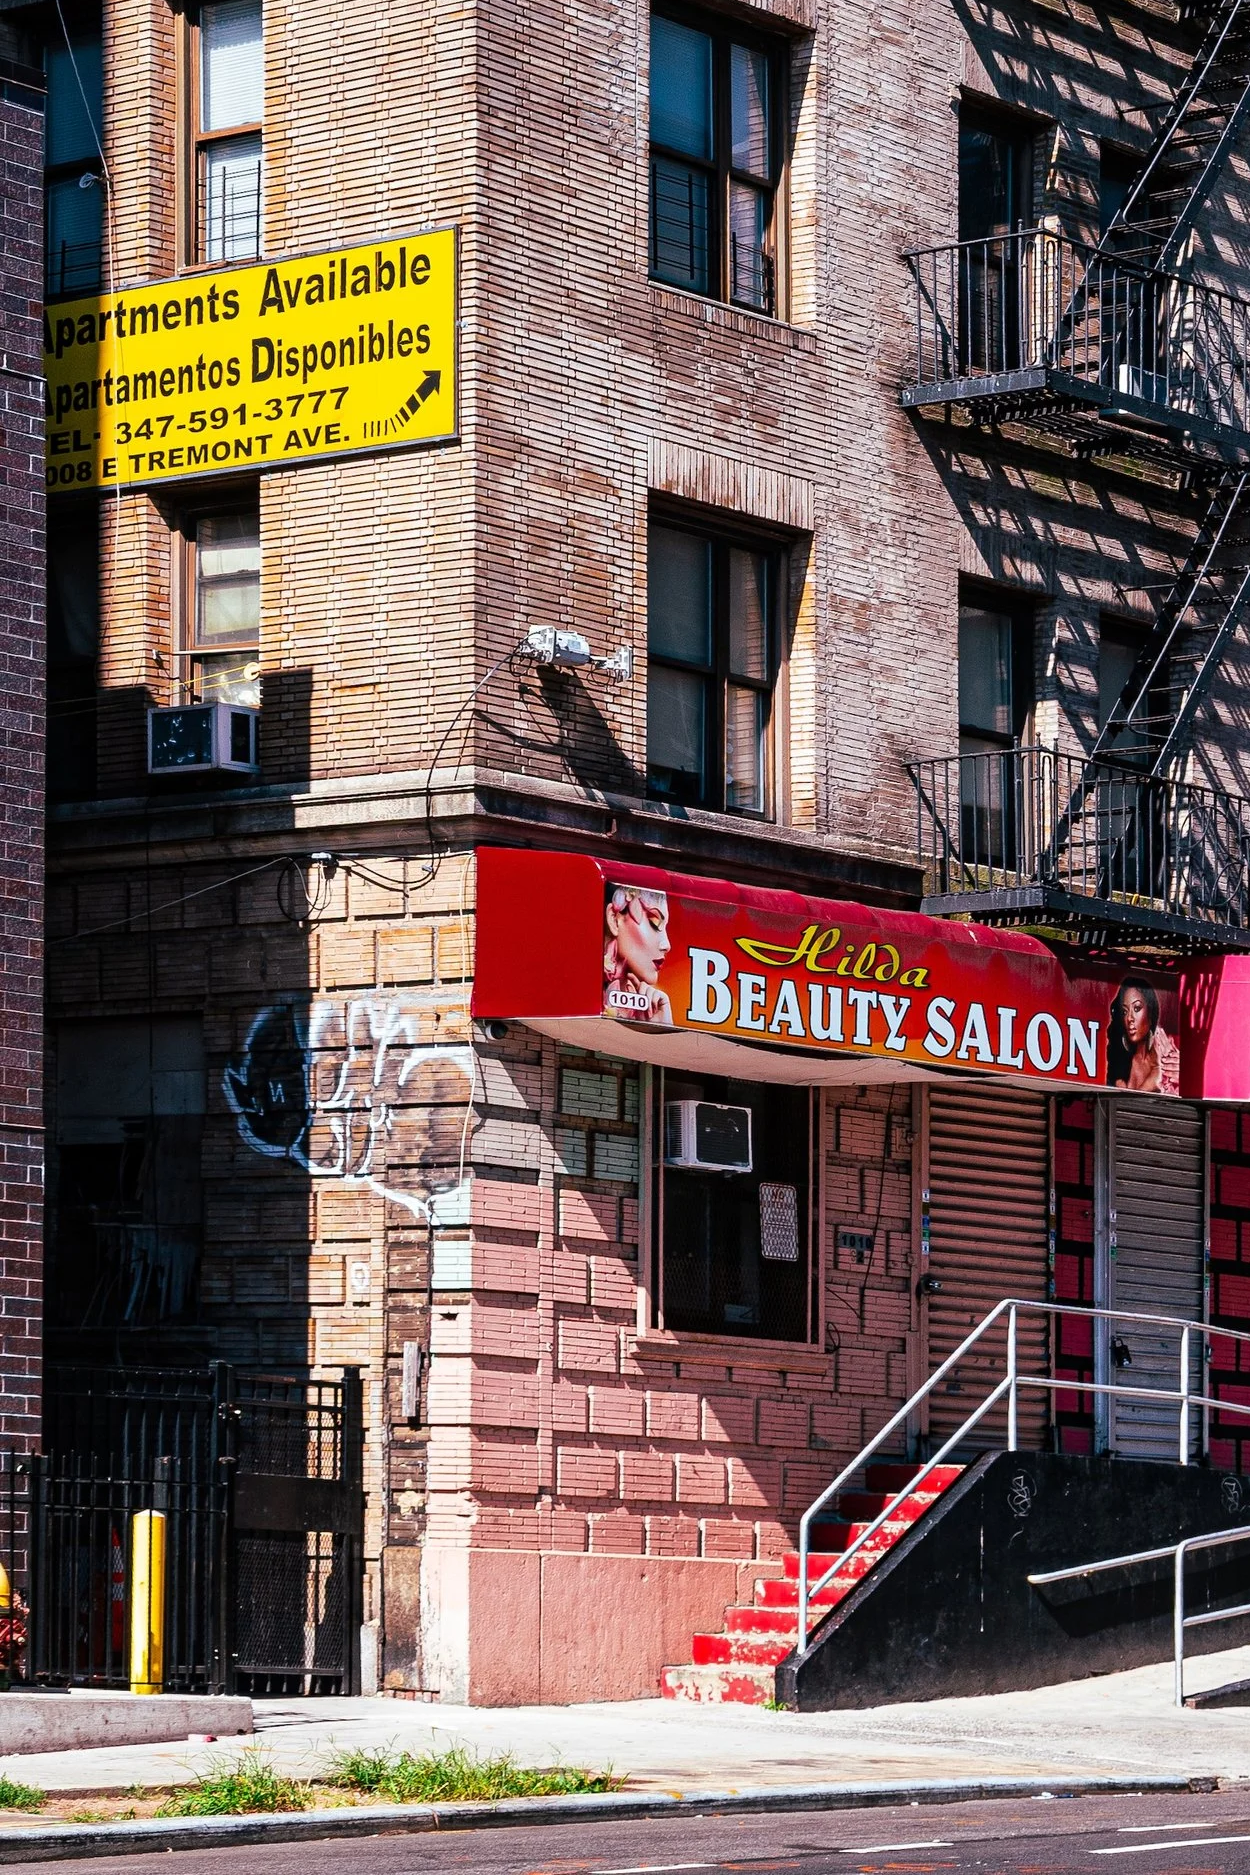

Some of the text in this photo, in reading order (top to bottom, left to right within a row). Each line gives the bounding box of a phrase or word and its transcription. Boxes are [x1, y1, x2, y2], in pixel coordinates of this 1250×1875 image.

[258, 247, 431, 316] Available
[251, 320, 431, 384] Disponibles
[115, 386, 350, 445] 347-591-3777
[102, 458, 118, 478] E
[129, 433, 273, 474] TREMONT
[283, 423, 350, 451] AVE.
[735, 924, 930, 988] Hilda
[611, 993, 647, 1009] 1010
[686, 946, 1100, 1078] BEAUTY SALON
[842, 1234, 873, 1249] 1010
